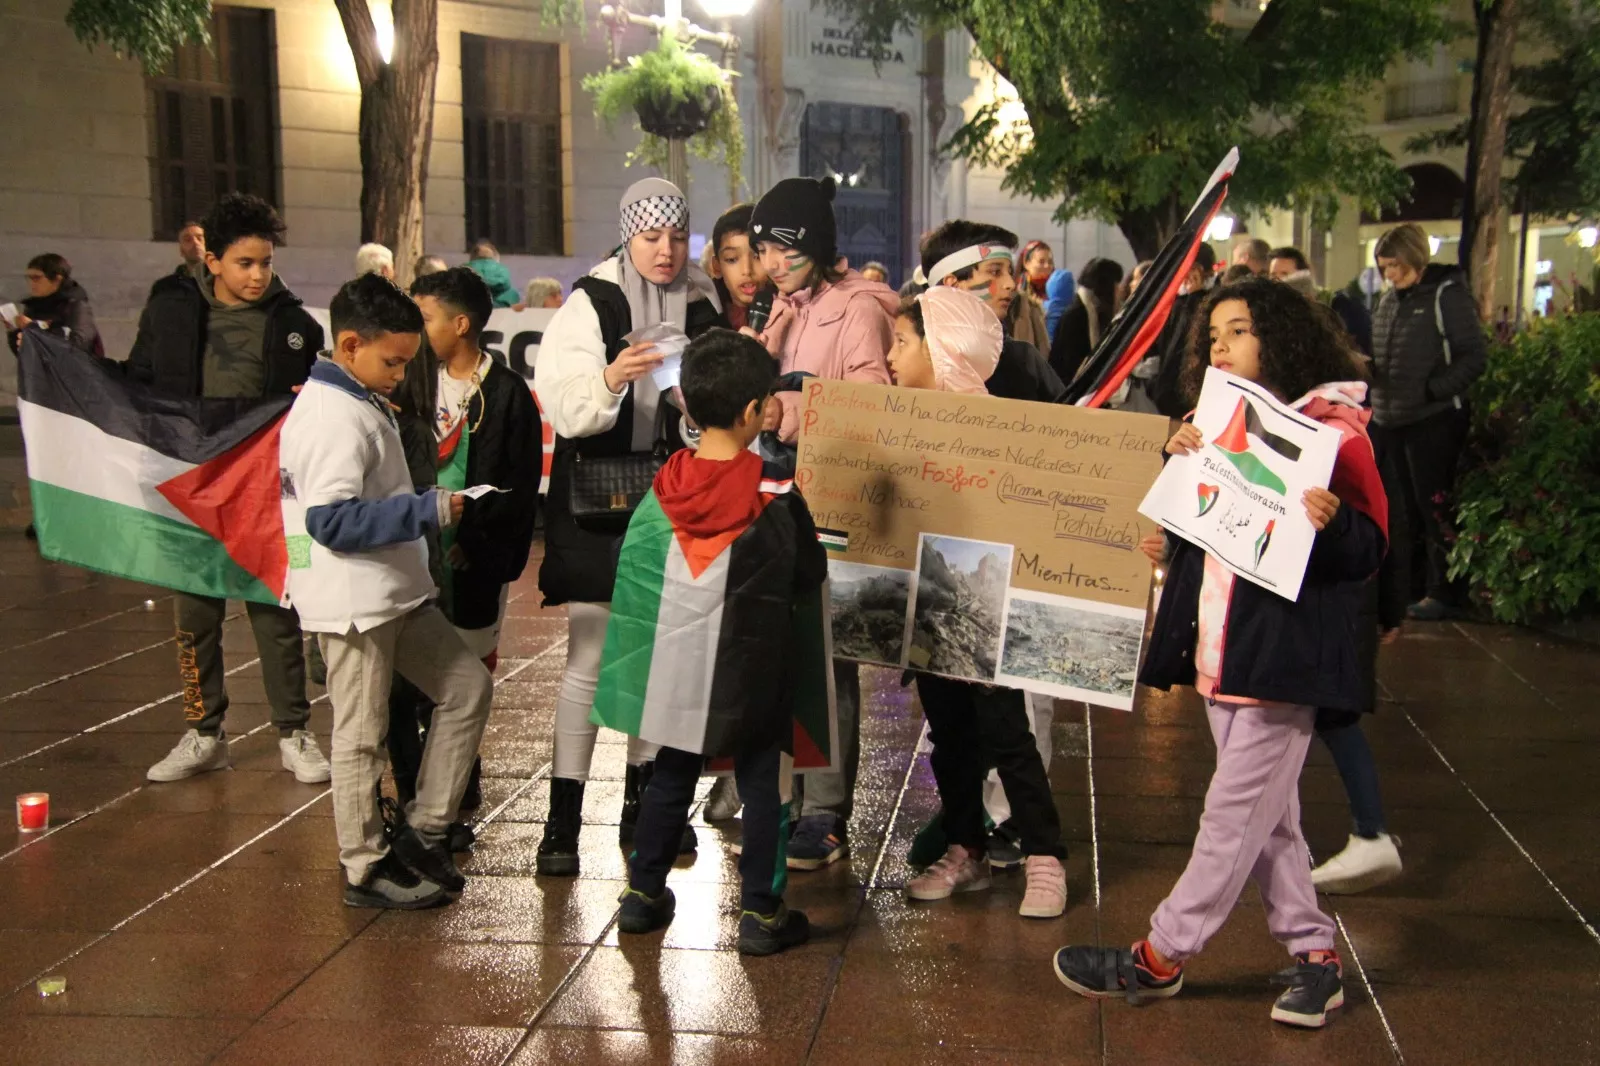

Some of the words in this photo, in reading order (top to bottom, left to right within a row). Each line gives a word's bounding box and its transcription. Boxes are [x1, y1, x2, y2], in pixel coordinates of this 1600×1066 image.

[884, 394, 906, 413] No
[910, 395, 932, 420] ha
[1039, 423, 1110, 450] ninguna
[802, 444, 885, 471] Bombardea
[875, 428, 898, 447] No
[902, 428, 946, 453] tiene
[948, 437, 1001, 459] Armas
[1089, 463, 1113, 480] Ni
